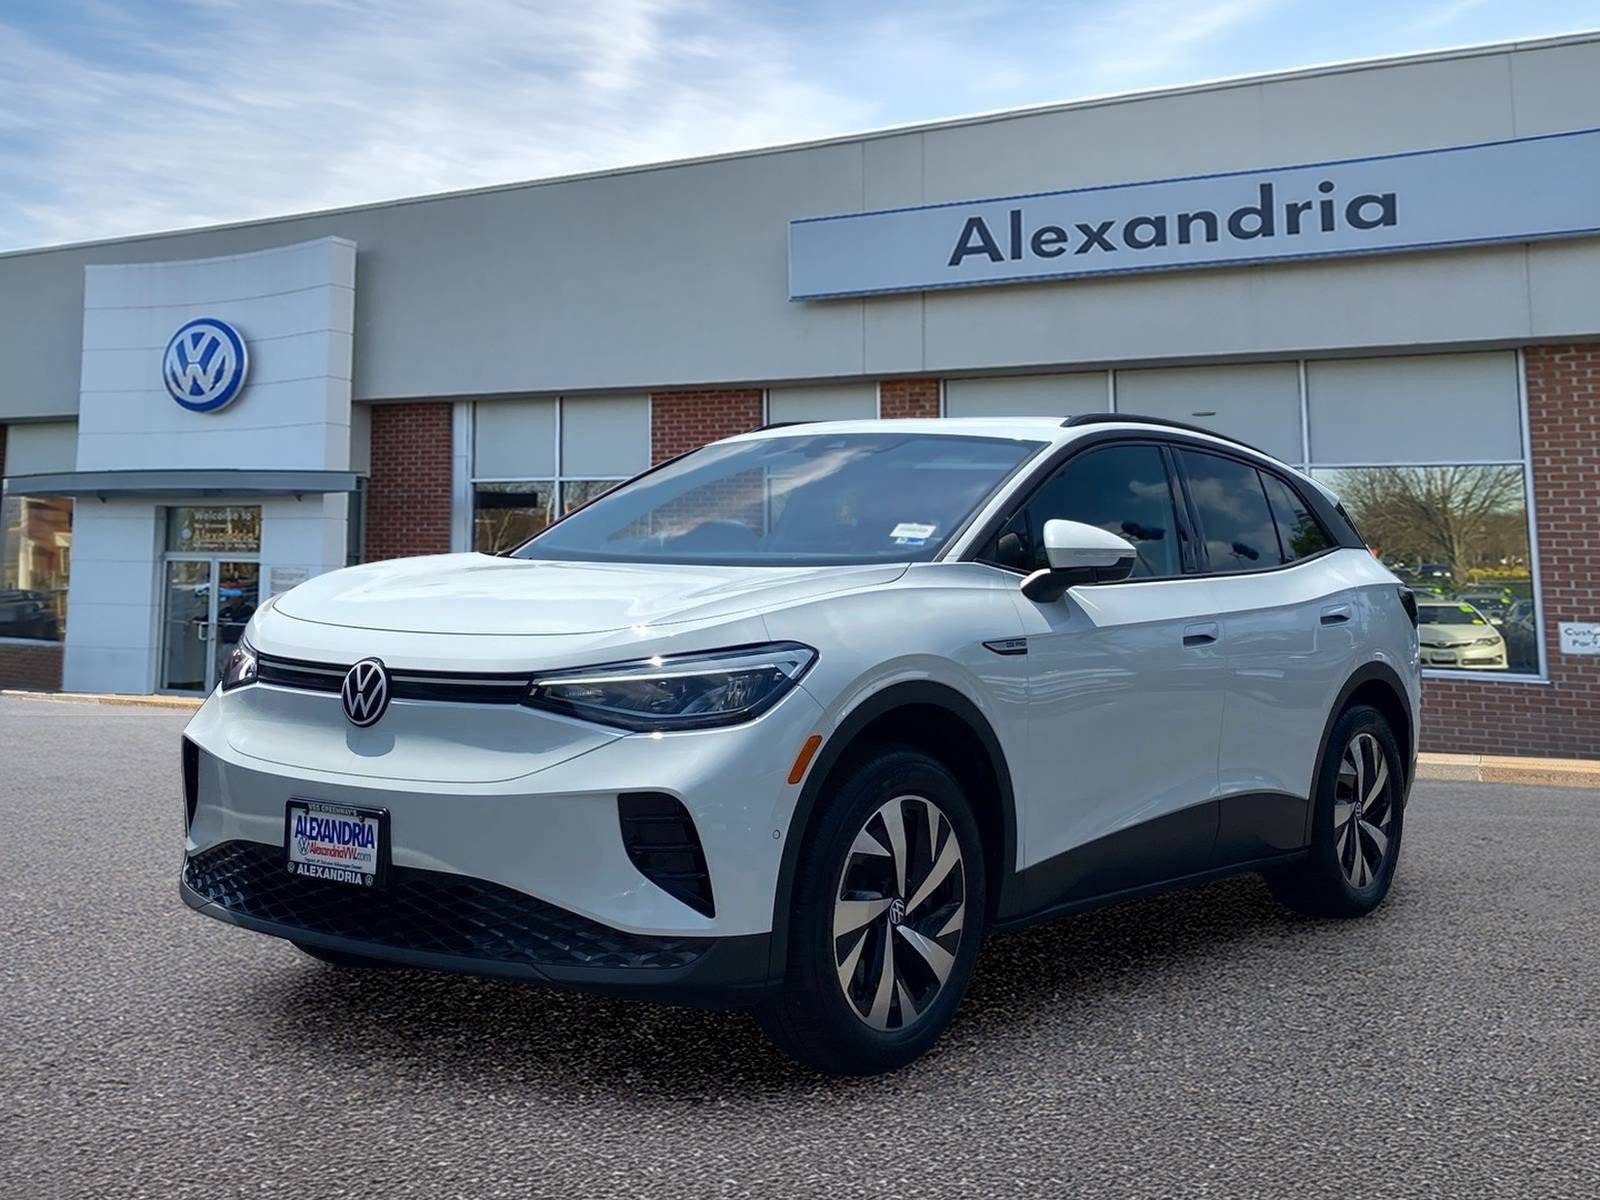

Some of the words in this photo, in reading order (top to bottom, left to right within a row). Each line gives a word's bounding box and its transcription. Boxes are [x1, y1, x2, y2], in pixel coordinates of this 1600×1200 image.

[948, 180, 1398, 267] Alexandria
[166, 325, 237, 403] VW
[343, 661, 386, 723] VW
[295, 815, 375, 849] ALEXANDRIA
[297, 863, 363, 885] ALEXANDRIA
